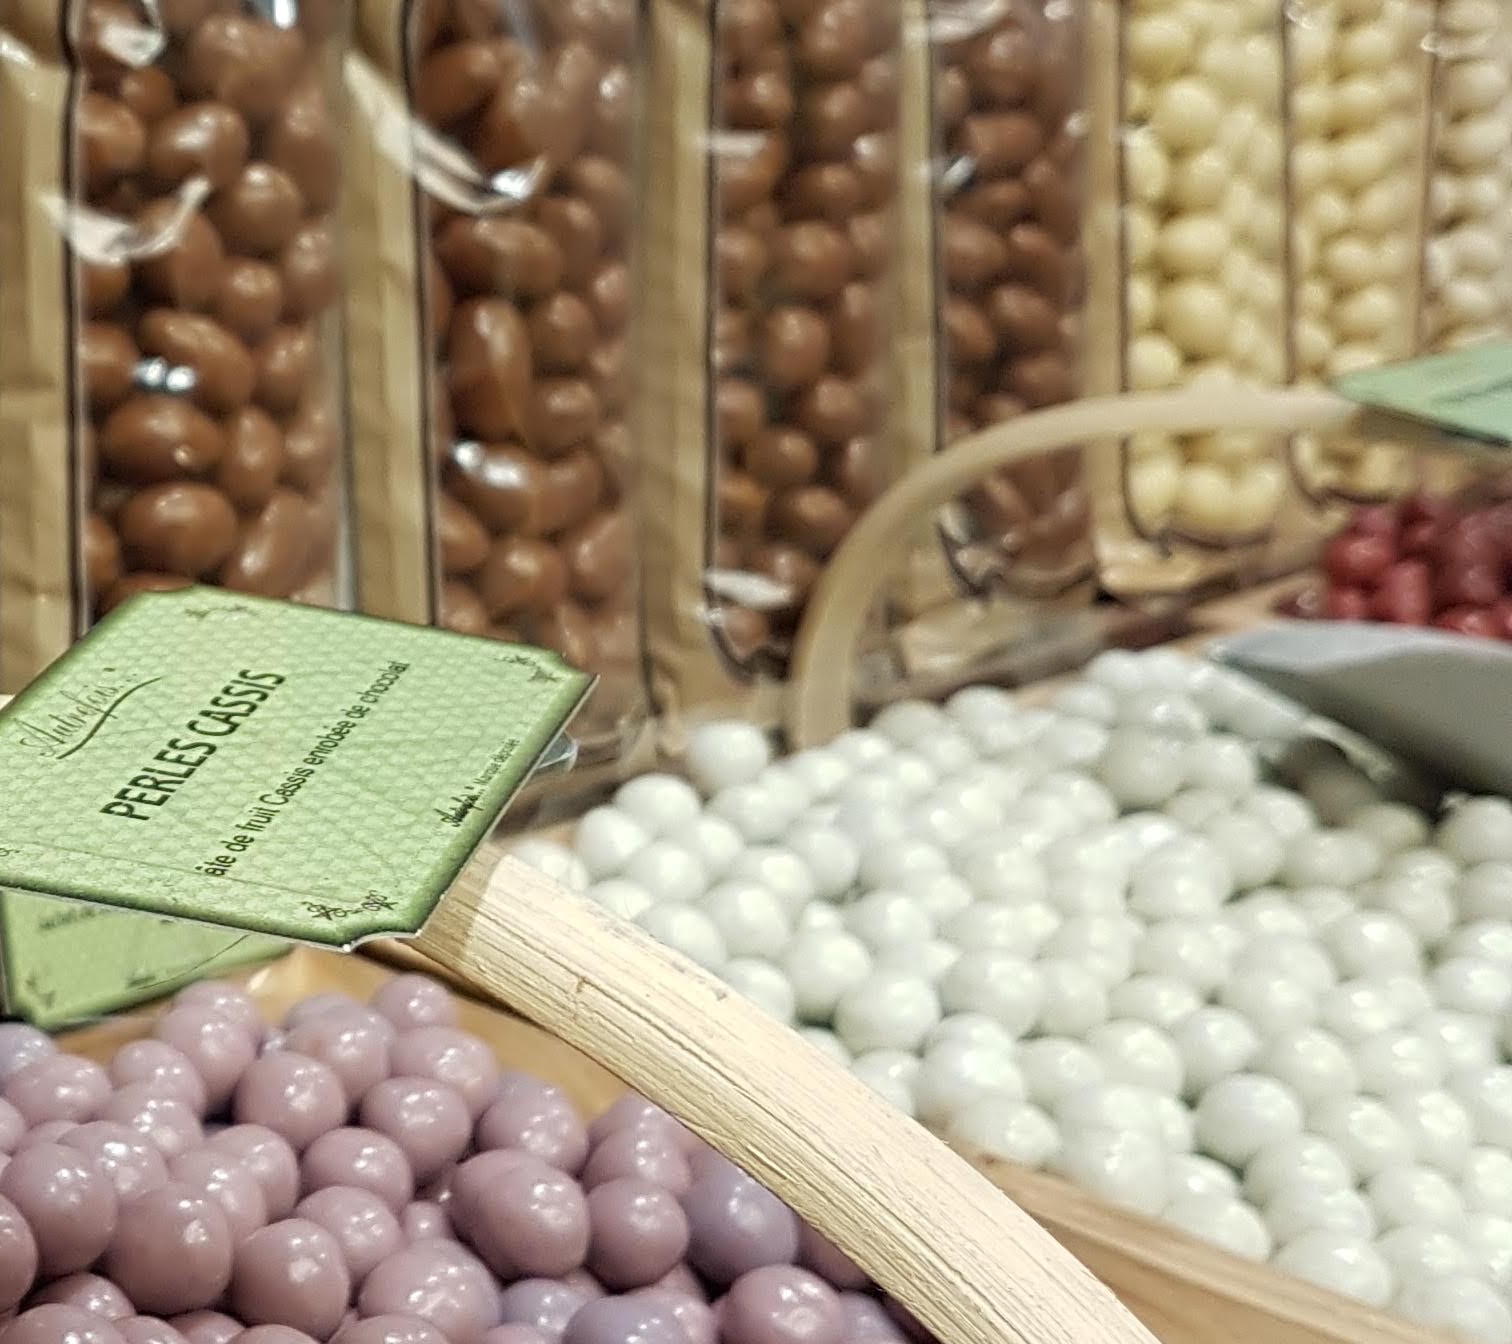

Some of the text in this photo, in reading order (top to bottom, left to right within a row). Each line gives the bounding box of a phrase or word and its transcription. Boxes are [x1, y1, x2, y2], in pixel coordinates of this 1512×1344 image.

[98, 669, 286, 822] PERLES CASSIS
[194, 660, 411, 877] âte de fruit Cassis enrobée de chocolat
